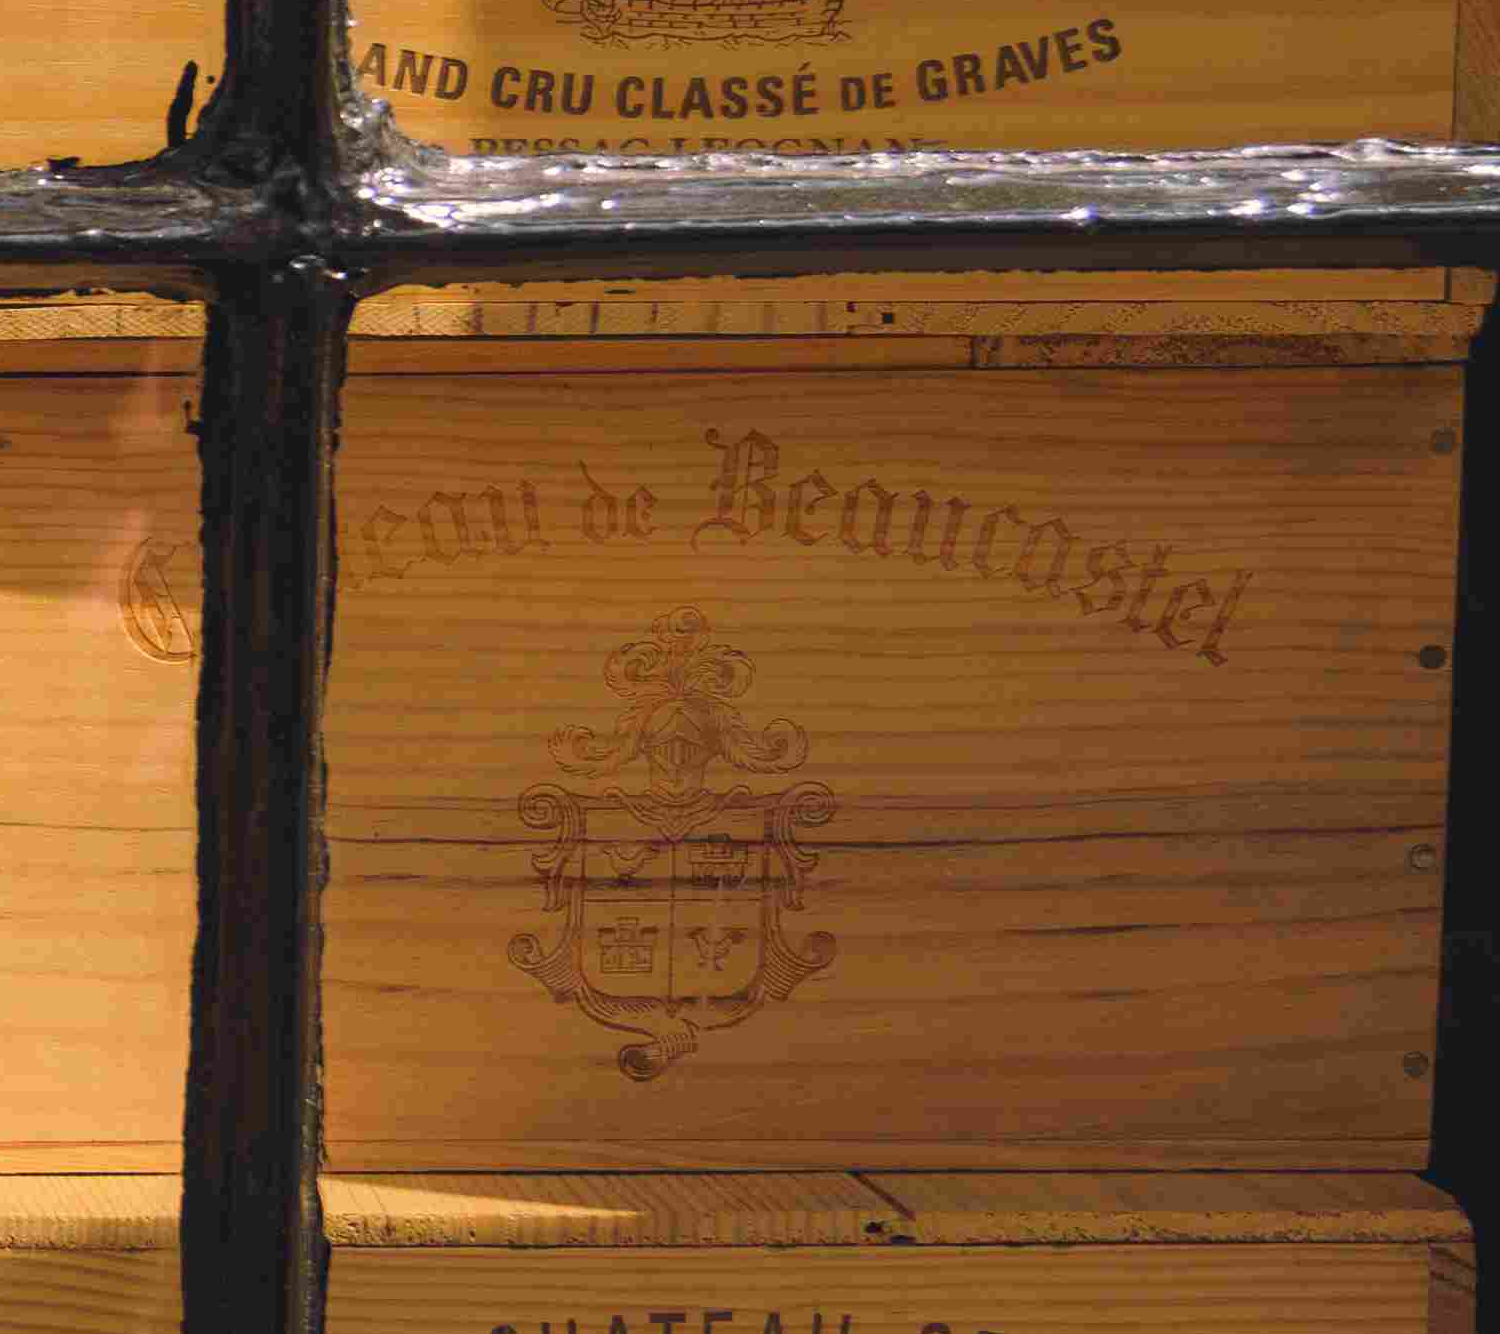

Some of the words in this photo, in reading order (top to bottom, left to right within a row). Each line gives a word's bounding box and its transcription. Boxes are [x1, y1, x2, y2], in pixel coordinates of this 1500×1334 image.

[357, 41, 470, 103] AND
[488, 64, 594, 117] CRU
[615, 59, 821, 121] CLASSÉ
[841, 74, 896, 112] DE
[916, 17, 1124, 106] GRAVES
[117, 475, 551, 667] Ceau
[580, 459, 660, 547] de
[689, 426, 1255, 669] Beaucastel
